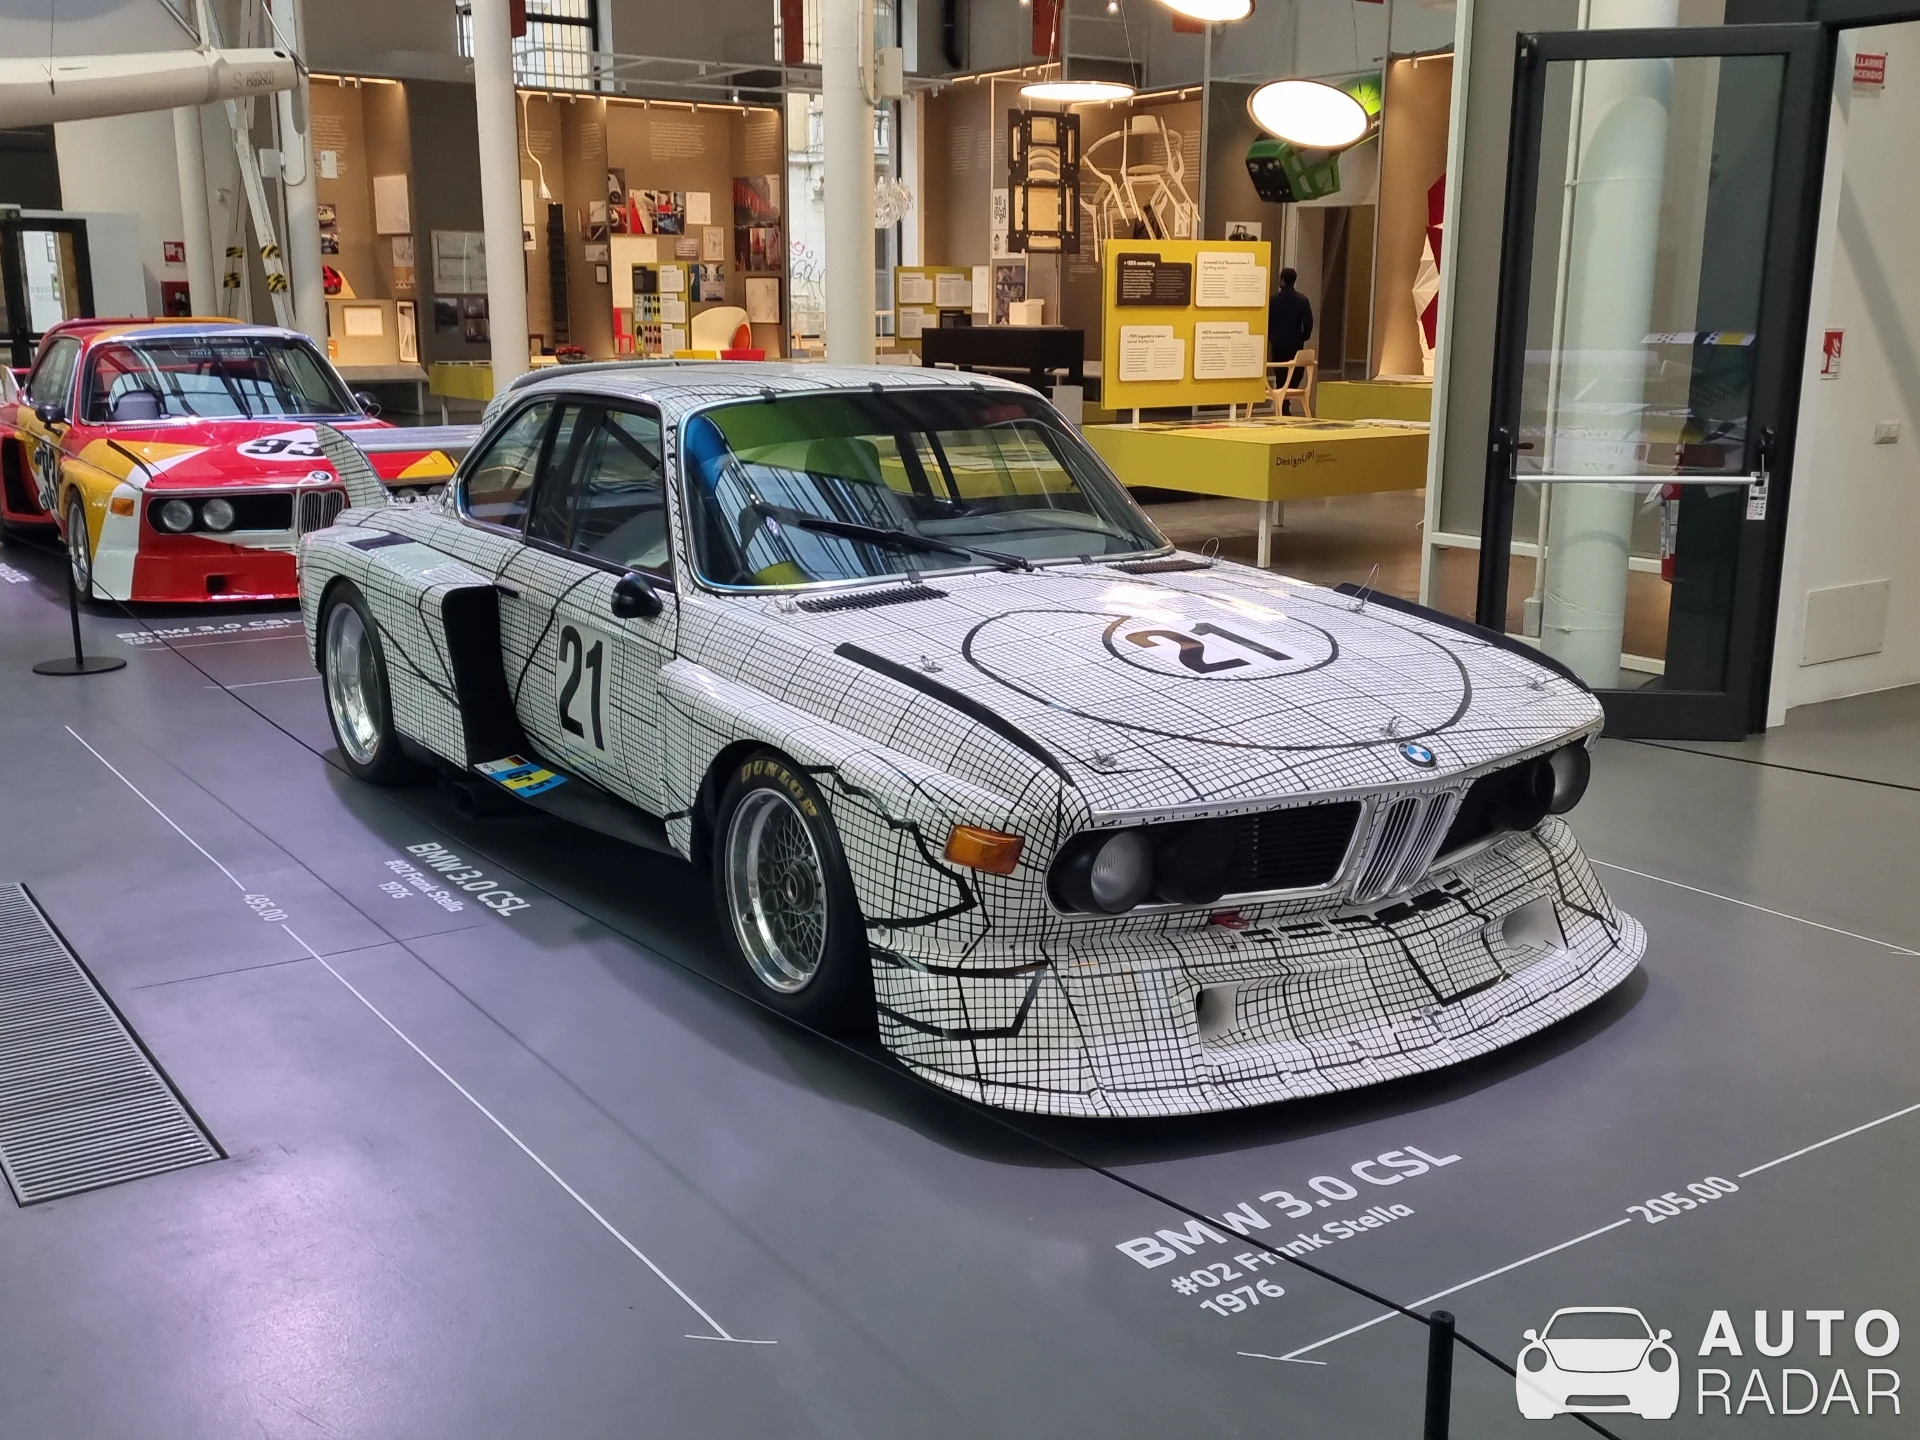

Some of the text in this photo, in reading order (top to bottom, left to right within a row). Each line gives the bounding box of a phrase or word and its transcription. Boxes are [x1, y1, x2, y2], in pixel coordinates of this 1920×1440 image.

[244, 438, 325, 457] 93
[1125, 622, 1295, 675] 21
[559, 625, 605, 751] 21
[741, 760, 817, 816] DUNLOP
[378, 880, 415, 899] 1976
[384, 859, 465, 913] #02 Frank Stella
[406, 842, 532, 917] BMW 3.0 CSL
[243, 894, 289, 921] 495.00
[1114, 1145, 1463, 1269] BMW 3.0 CSL
[1625, 1176, 1740, 1224] 205.00
[1171, 1263, 1243, 1296] #02
[1322, 1203, 1416, 1241] Stella
[1200, 1278, 1286, 1317] 1976
